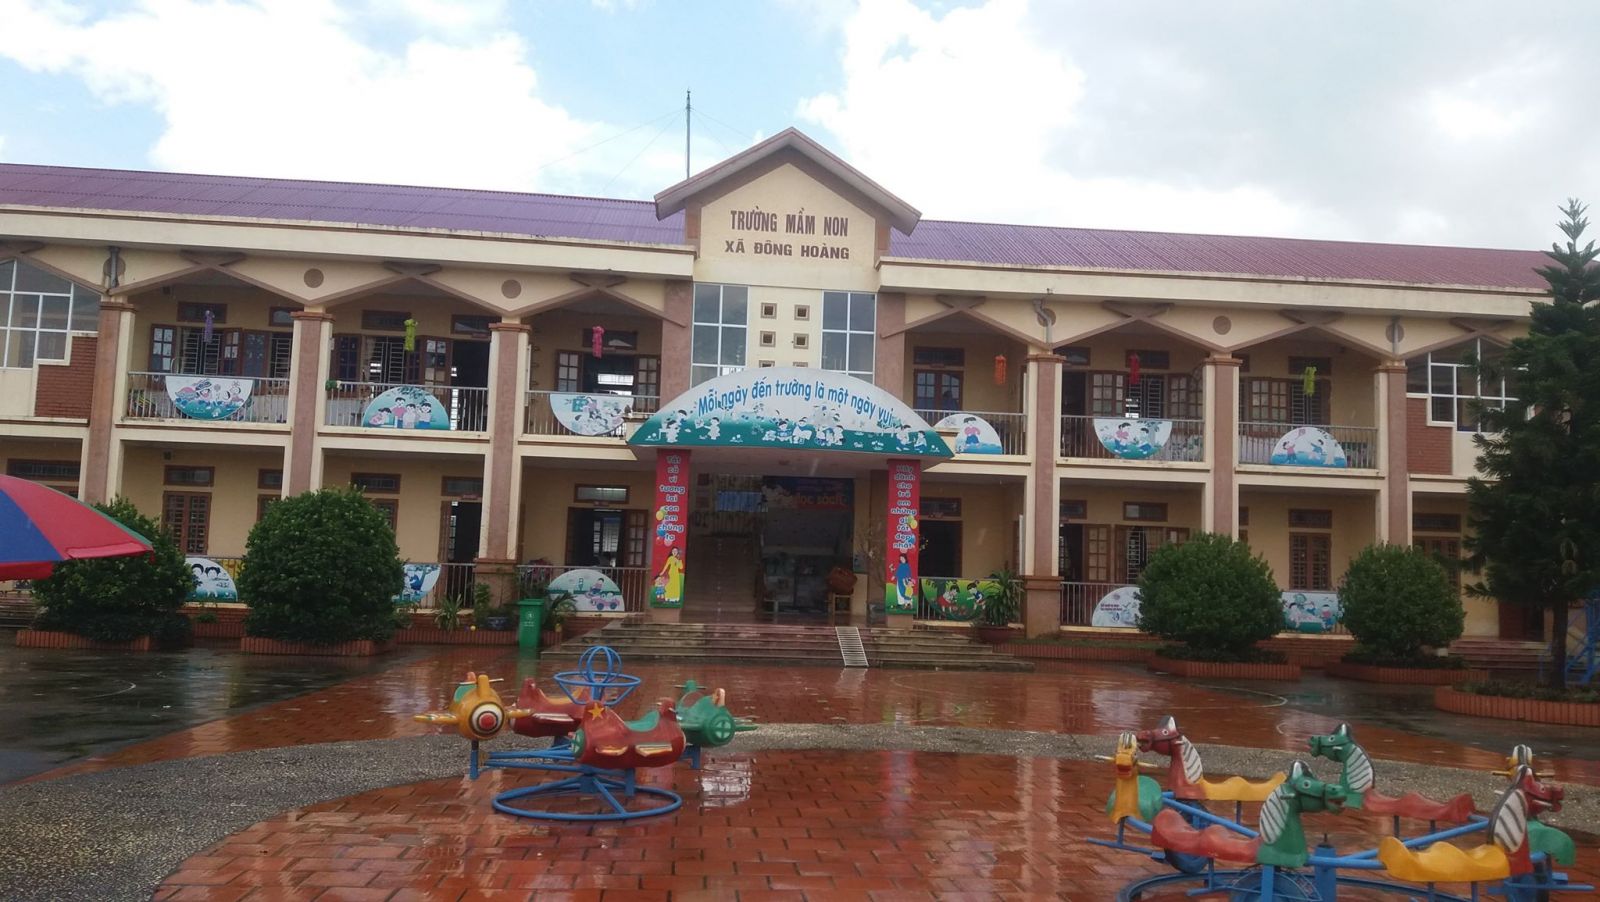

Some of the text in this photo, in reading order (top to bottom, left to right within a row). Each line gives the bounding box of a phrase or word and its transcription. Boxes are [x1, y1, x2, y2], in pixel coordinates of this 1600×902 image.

[730, 206, 849, 237] TRƯỜNG MẦM NON
[725, 239, 745, 253] XÃ
[801, 243, 849, 259] HOÀNG
[698, 376, 894, 425] Mỗi ngày đến trường là một ngày vui
